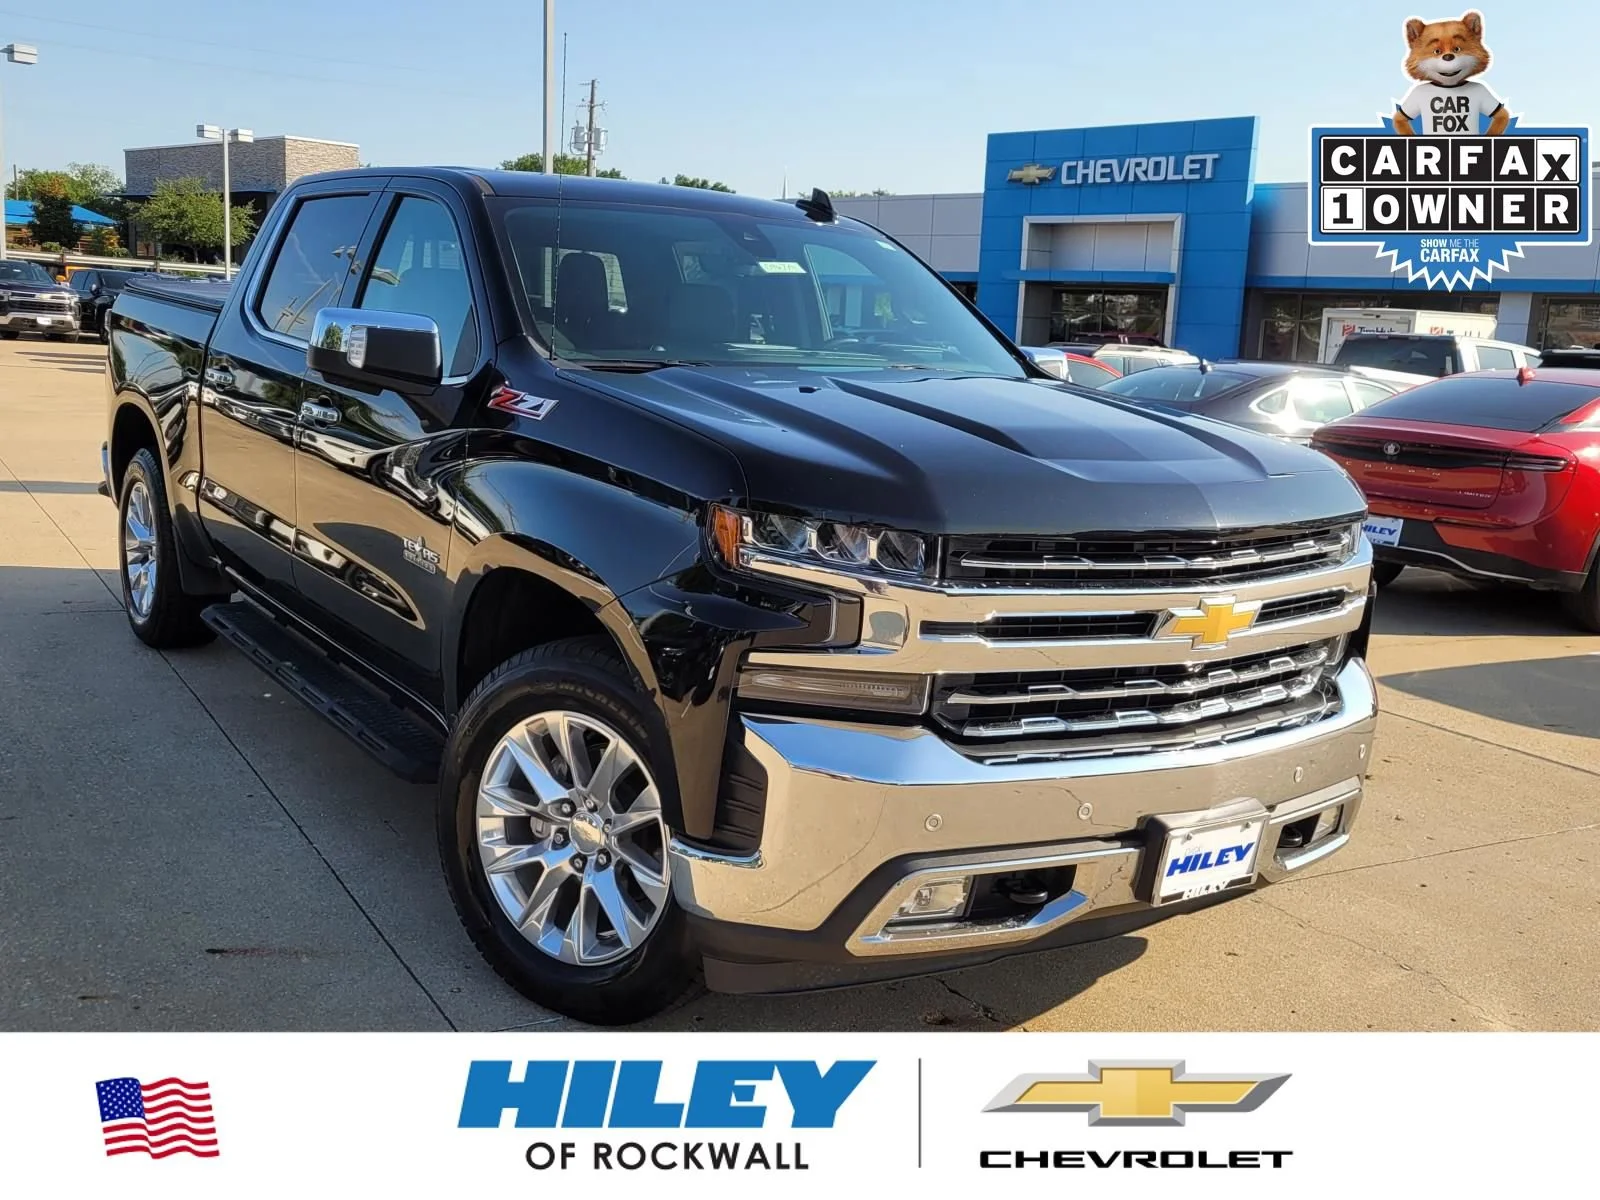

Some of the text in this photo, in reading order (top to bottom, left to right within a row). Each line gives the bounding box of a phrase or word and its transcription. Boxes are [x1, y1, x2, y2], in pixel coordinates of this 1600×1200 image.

[1060, 153, 1220, 185] CHEVROLET
[487, 385, 559, 421] Z71
[1166, 842, 1255, 877] HILEY
